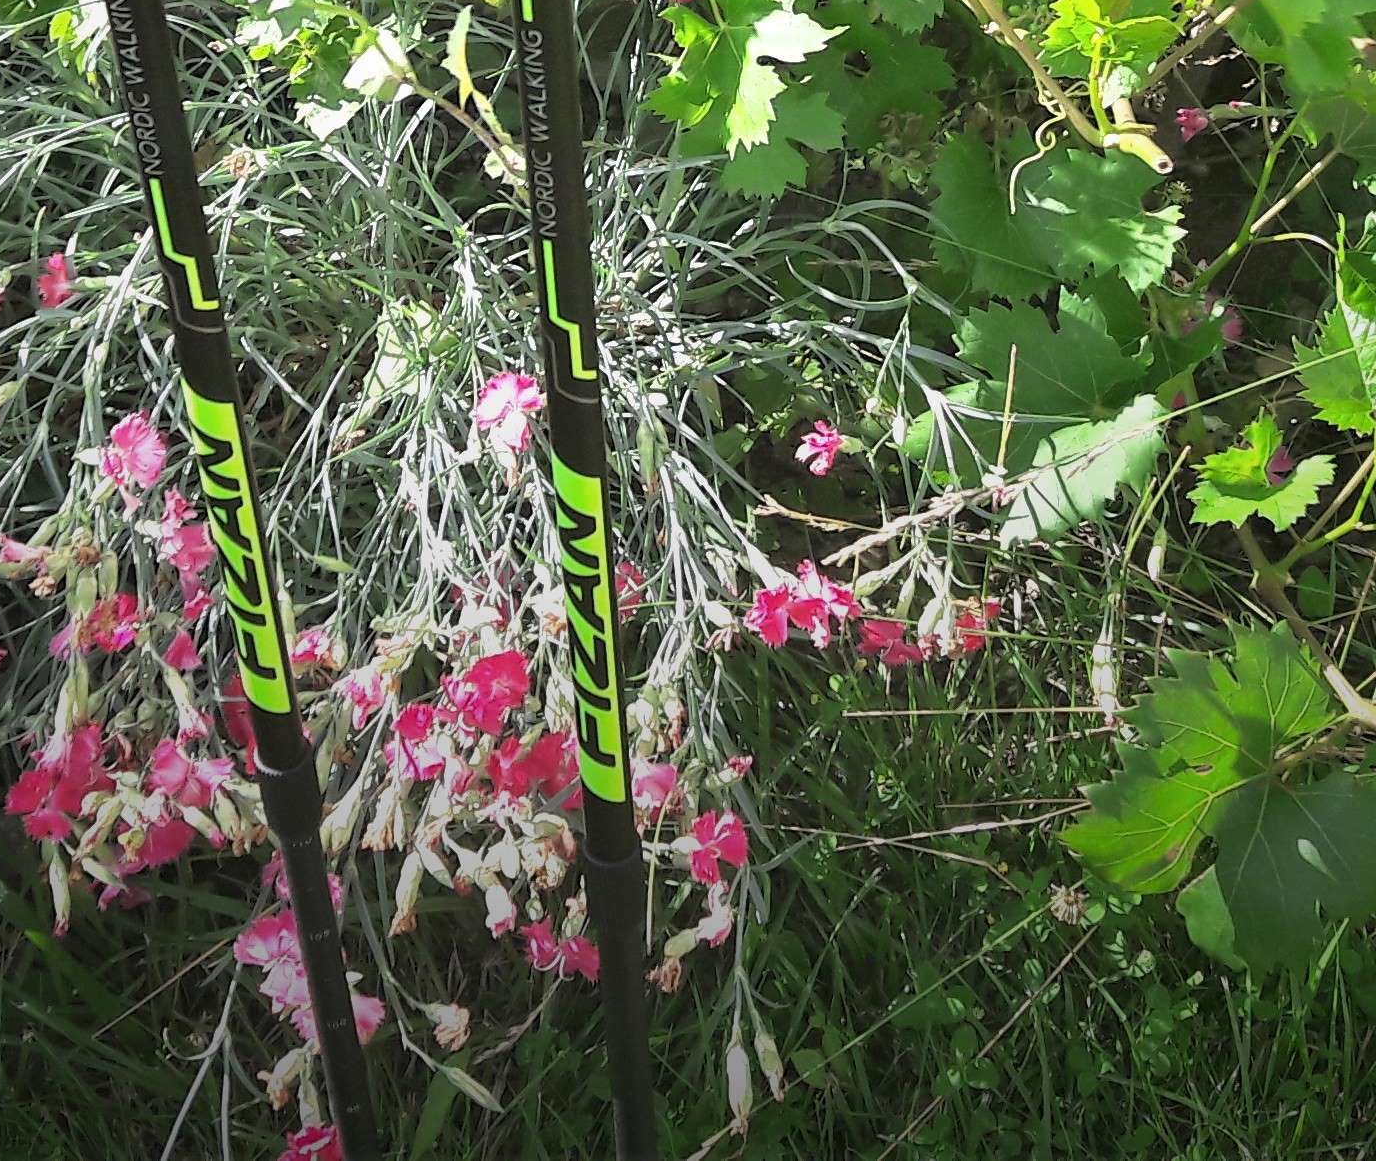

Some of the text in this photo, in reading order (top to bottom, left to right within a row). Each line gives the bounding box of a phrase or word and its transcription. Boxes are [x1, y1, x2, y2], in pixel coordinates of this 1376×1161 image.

[128, 91, 165, 176] NORDIC
[521, 29, 558, 237] NORDIC WALKING
[188, 417, 277, 681] FIZAN
[555, 491, 616, 768] FIZAN
